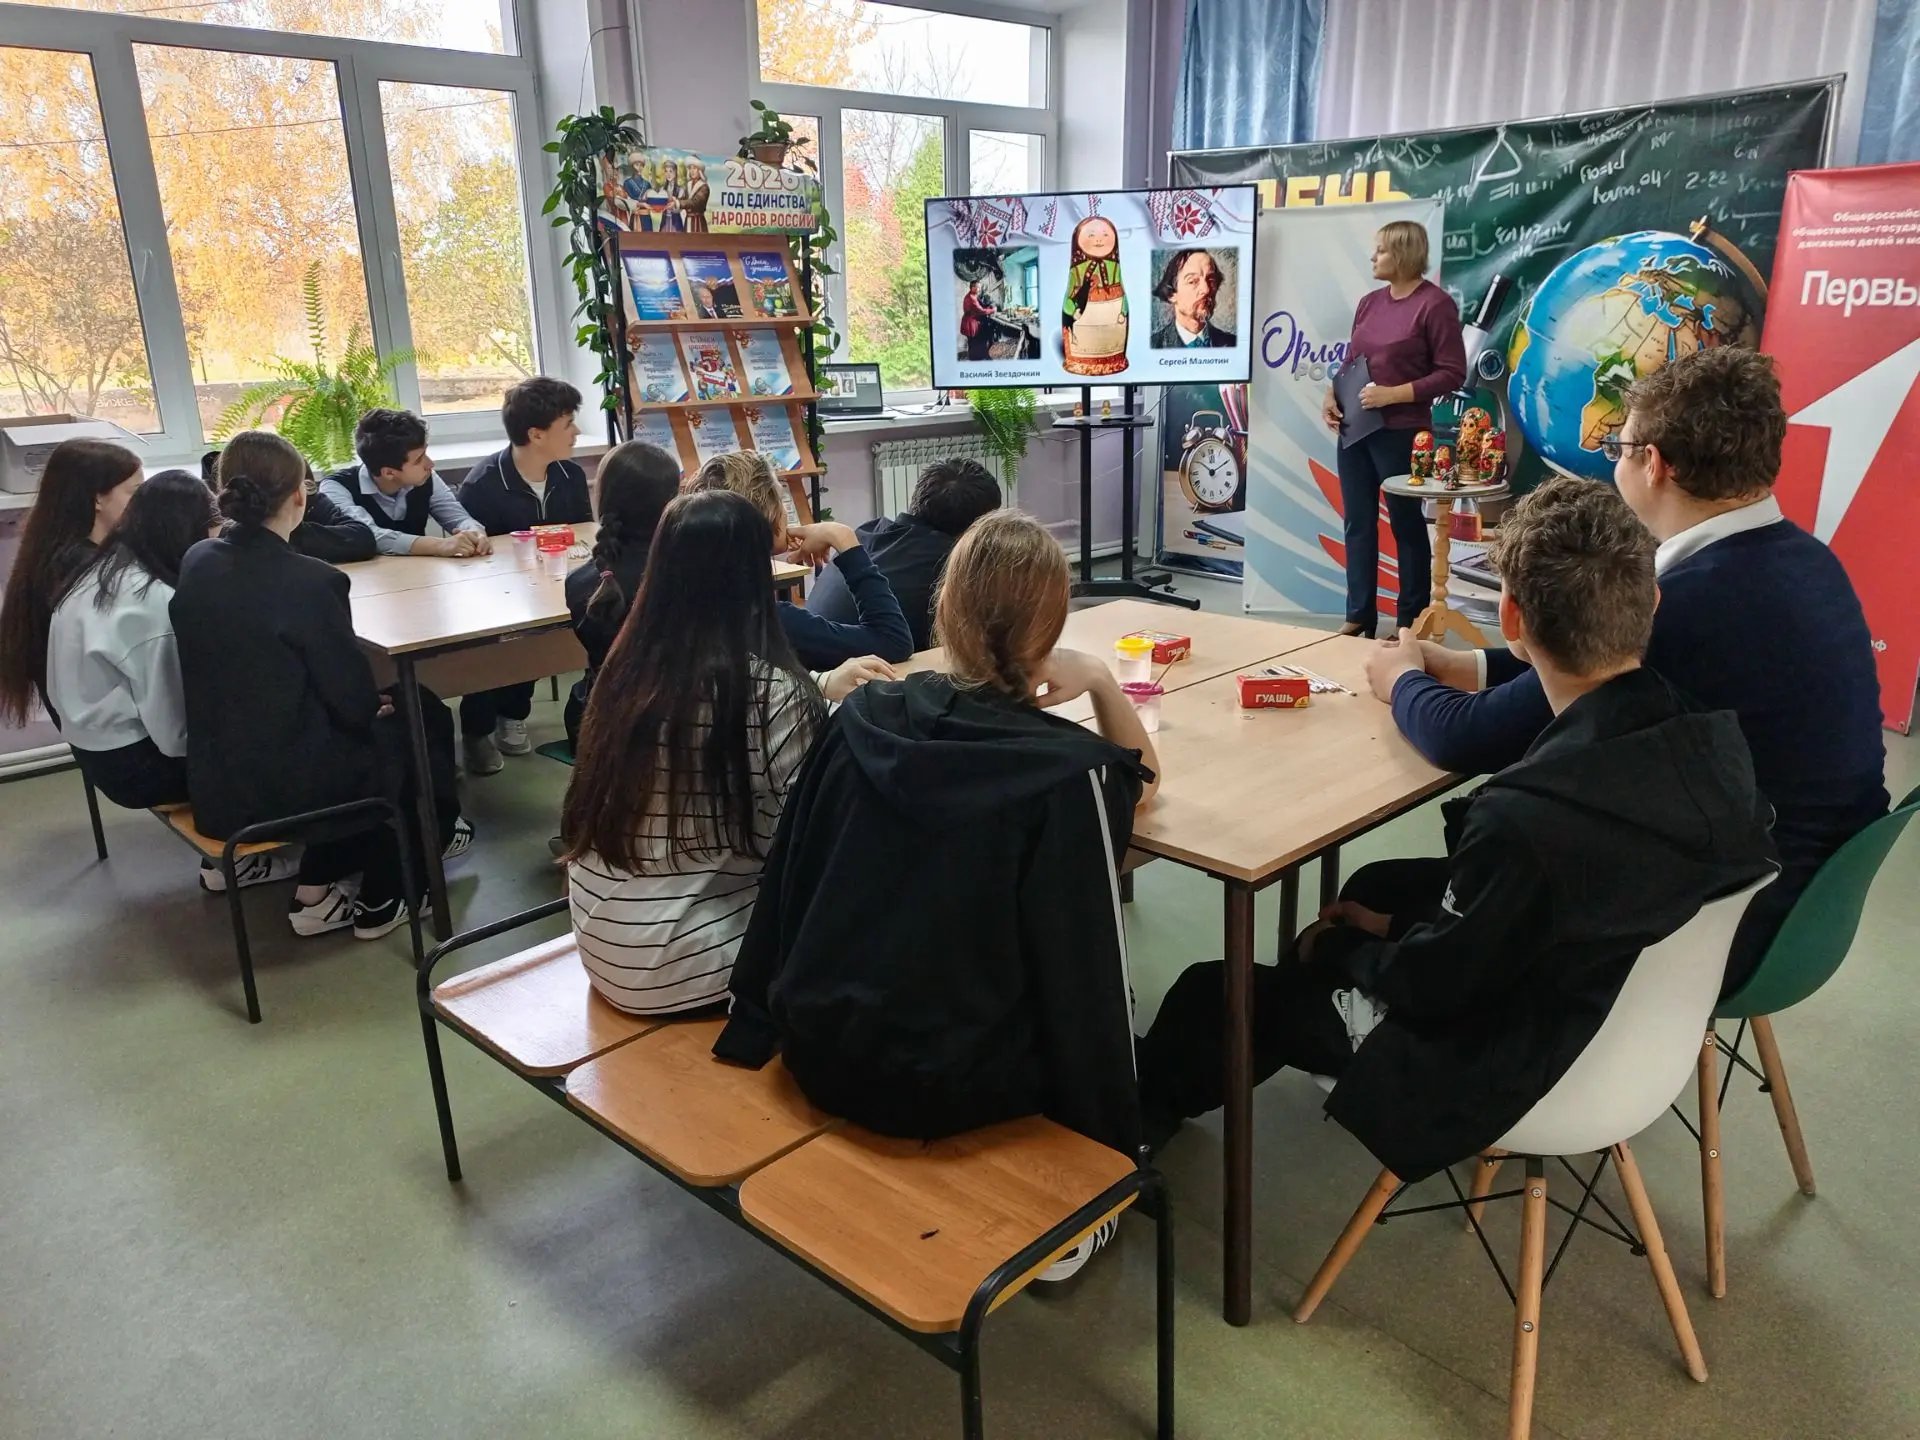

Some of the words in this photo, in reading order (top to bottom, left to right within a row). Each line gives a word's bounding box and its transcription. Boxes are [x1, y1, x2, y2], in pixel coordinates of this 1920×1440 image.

[721, 191, 745, 208] ГОД
[747, 191, 806, 209] ЕДИНСТВА
[711, 211, 768, 228] НАРОДОВ
[770, 212, 816, 228] РОССИИ
[1800, 270, 1920, 317] Первы
[1262, 311, 1351, 374] Орля
[1159, 358, 1187, 366] Сергей
[1189, 357, 1229, 365] Малютин
[959, 370, 993, 379] Василий
[994, 370, 1041, 378] Звездочкин
[1294, 362, 1341, 381] РОС
[1255, 694, 1294, 703] ГУАШЬ
